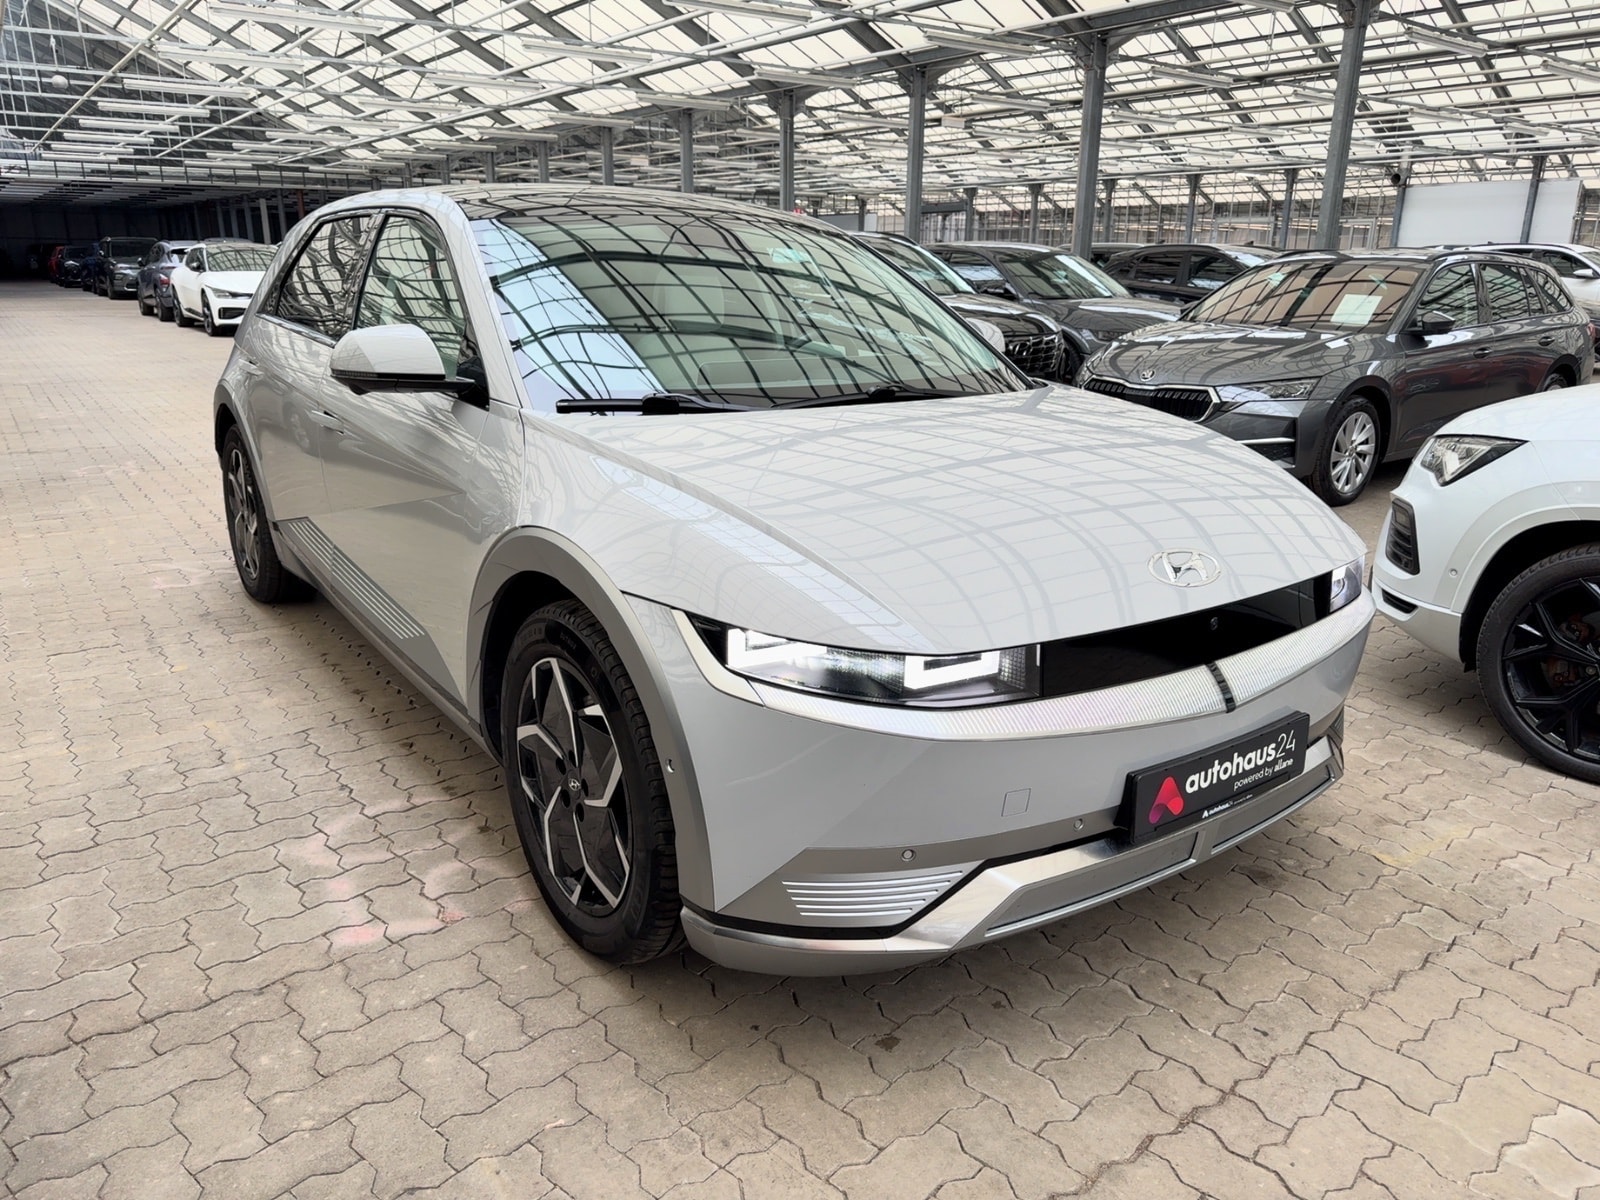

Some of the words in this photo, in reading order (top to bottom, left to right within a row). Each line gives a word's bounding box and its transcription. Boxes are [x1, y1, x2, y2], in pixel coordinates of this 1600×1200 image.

[1185, 729, 1296, 794] autohaus24
[1233, 767, 1264, 792] powered
[1264, 766, 1274, 777] by
